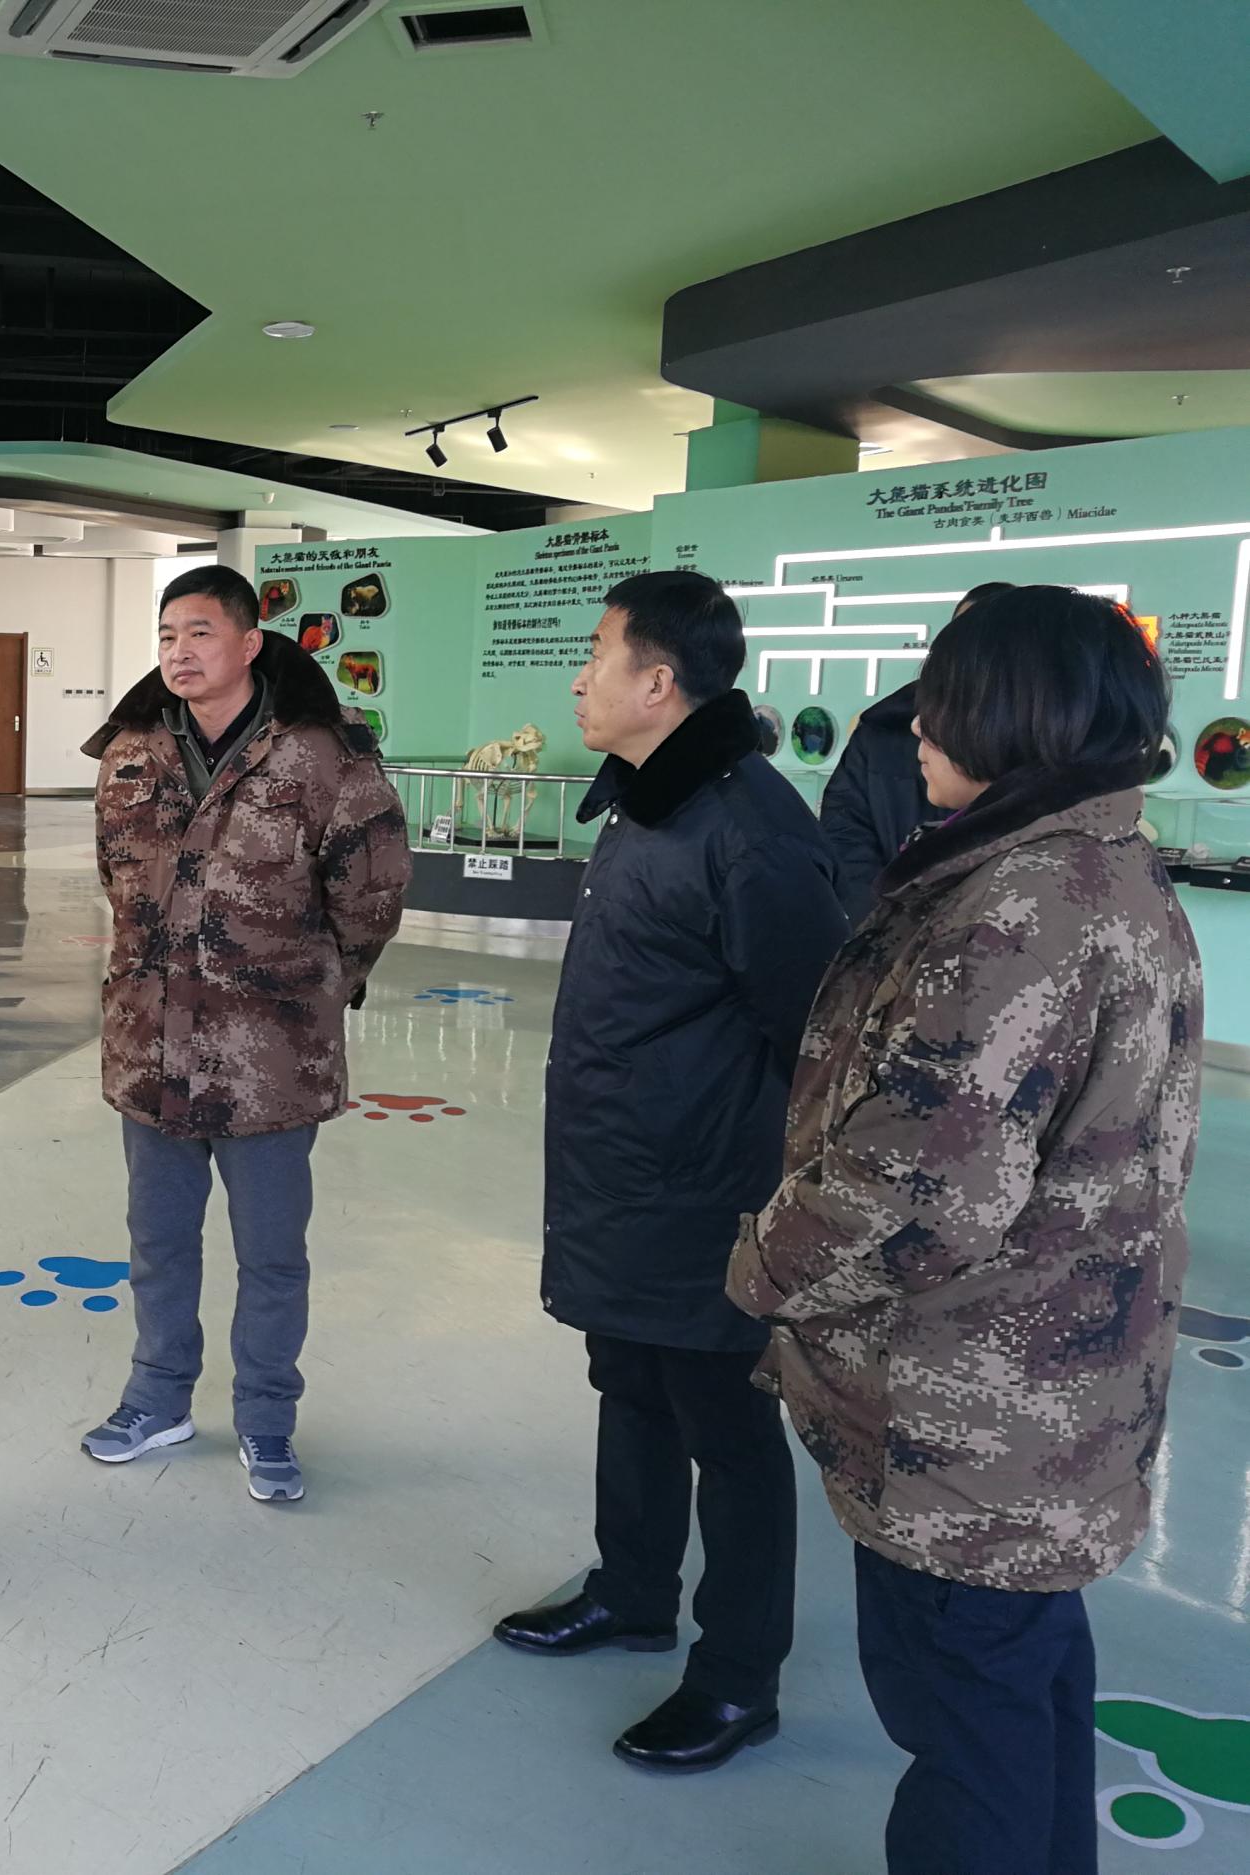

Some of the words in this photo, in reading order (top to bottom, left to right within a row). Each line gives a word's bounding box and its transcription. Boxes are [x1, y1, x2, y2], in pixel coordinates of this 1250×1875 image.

[867, 471, 1048, 505] 大熊猫系统进化图
[876, 508, 895, 519] The
[897, 505, 925, 517] Giant
[1008, 496, 1034, 508] Tree
[1067, 506, 1118, 521] Miacidae
[270, 547, 380, 564] 大熊猫的天敌和朋友
[468, 858, 509, 871] 禁止踩踏
